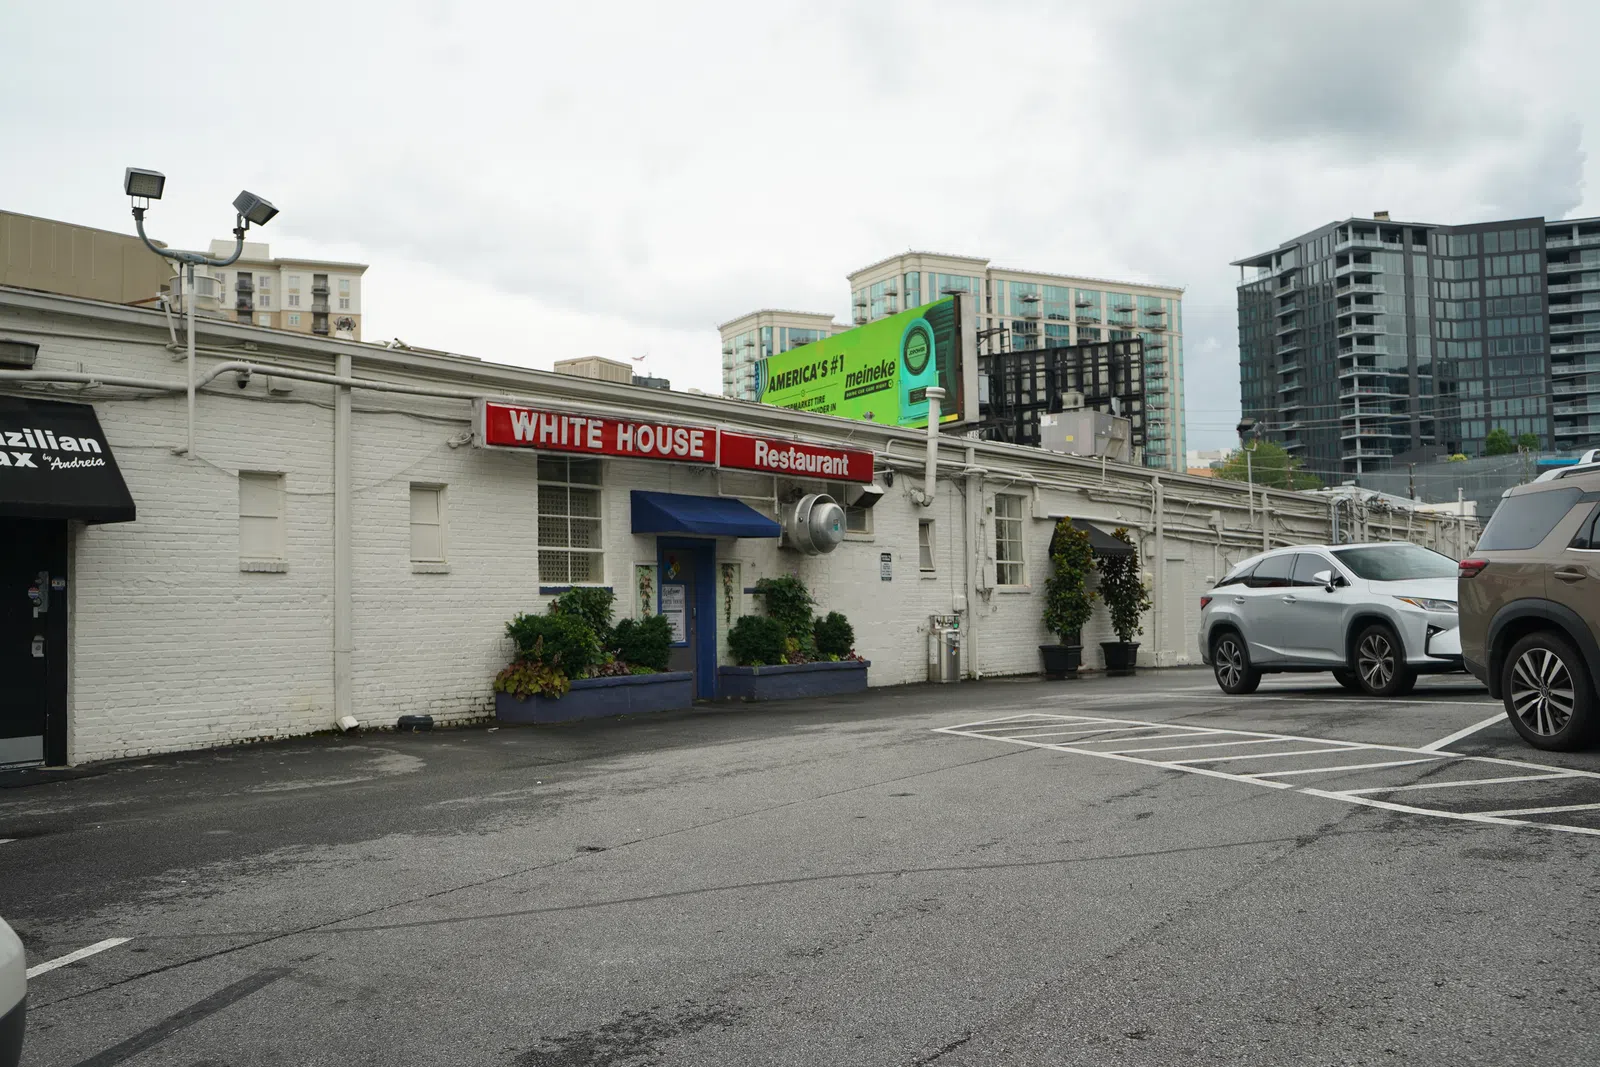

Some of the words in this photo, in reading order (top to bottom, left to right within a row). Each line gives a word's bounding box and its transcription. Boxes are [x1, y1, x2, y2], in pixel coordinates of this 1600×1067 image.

[768, 359, 828, 393] AMERICA'S
[830, 354, 844, 376] #1
[845, 359, 896, 388] meineke
[777, 398, 814, 411] ERMARKET
[814, 394, 826, 405] TIRE
[807, 404, 830, 414] VIDER
[830, 402, 837, 411] IN
[0, 428, 102, 453] zilian
[509, 410, 604, 449] WHITE
[616, 423, 705, 458] HOUSE
[42, 453, 53, 463] by
[50, 456, 106, 471] Andreia
[754, 440, 849, 476] Restaurant
